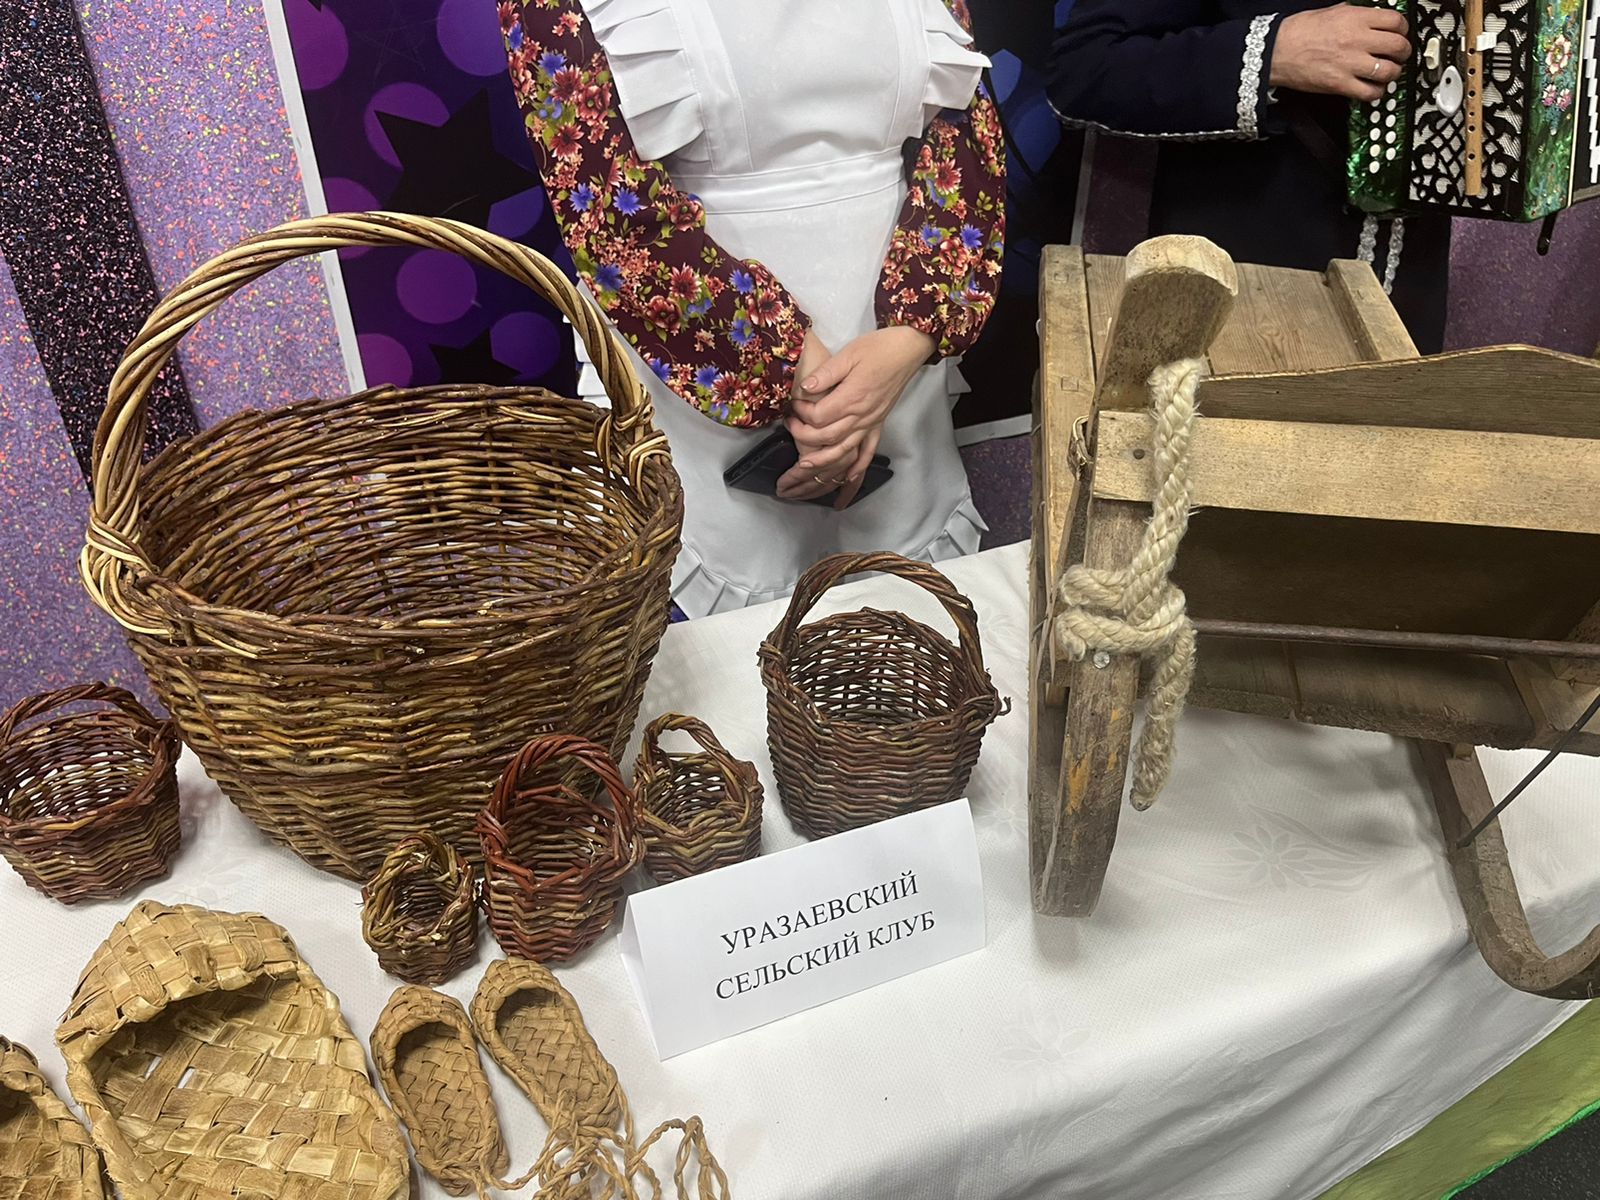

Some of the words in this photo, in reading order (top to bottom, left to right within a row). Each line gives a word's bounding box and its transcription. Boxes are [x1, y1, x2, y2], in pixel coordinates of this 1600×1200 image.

[715, 931, 861, 1000] СЕЛЬСКИЙ
[867, 911, 936, 950] КЛУБ
[721, 869, 919, 955] УРАЗАЕВСКИЙ
